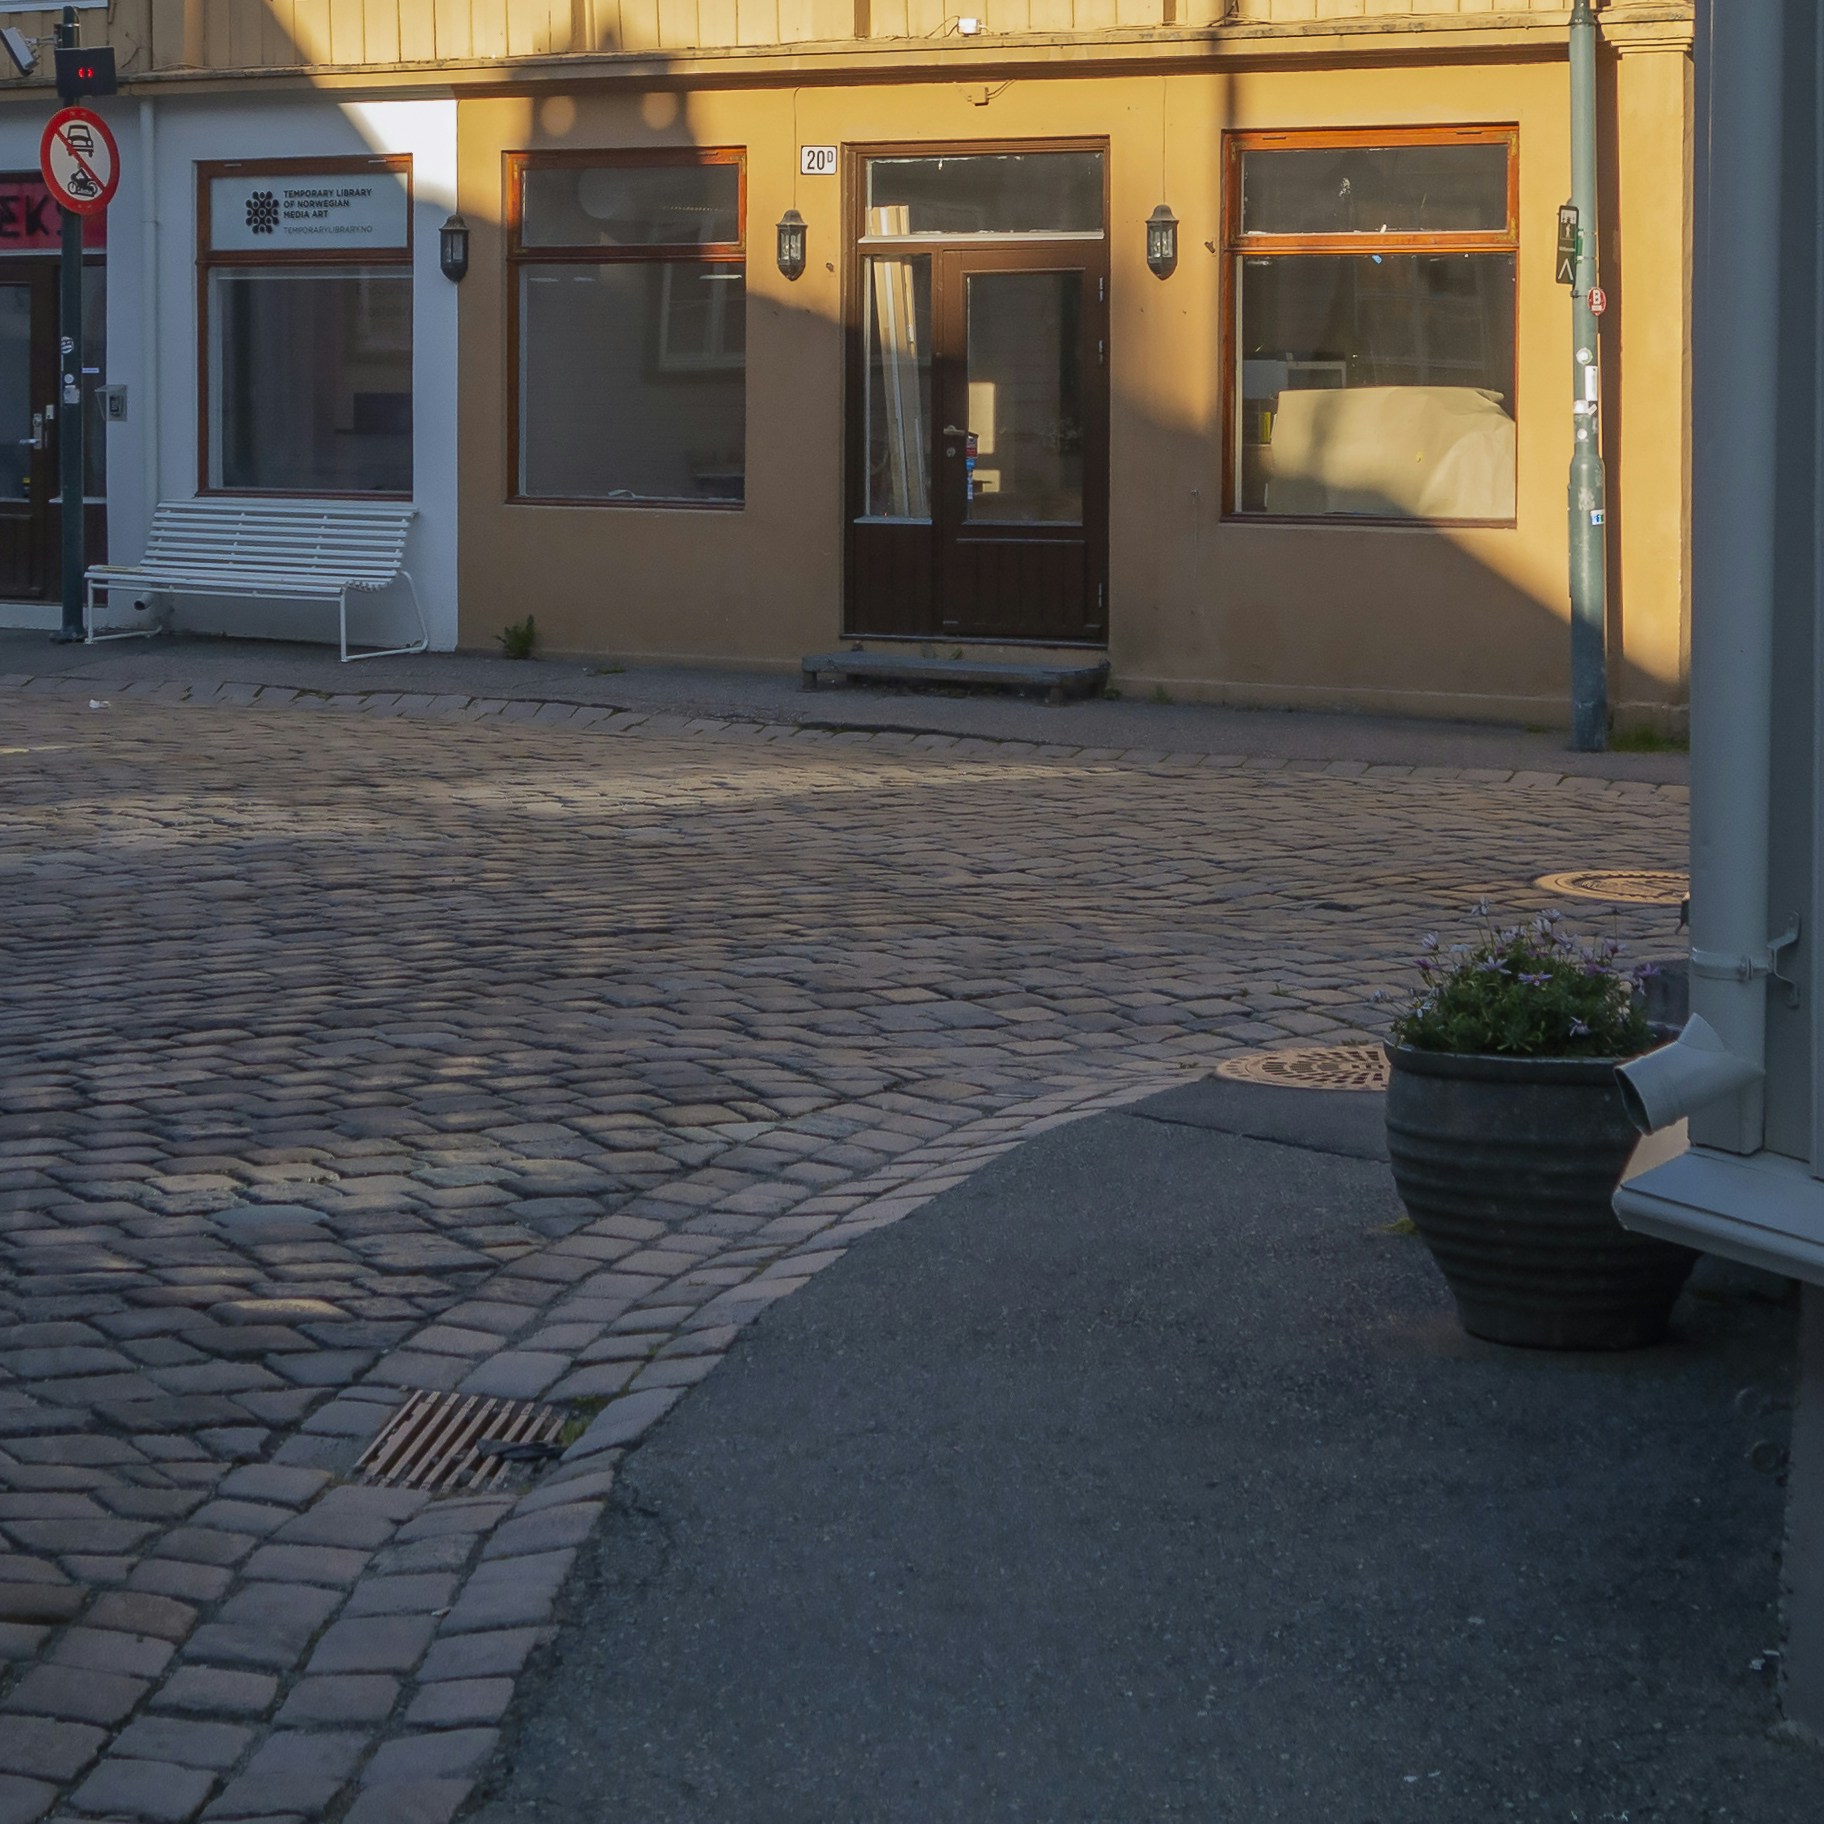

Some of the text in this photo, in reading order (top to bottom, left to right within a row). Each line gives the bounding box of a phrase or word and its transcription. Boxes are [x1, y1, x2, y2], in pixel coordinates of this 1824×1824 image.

[283, 188, 373, 198] TEMPORARY LIBRARY
[283, 199, 350, 208] OF NORWEGIAN
[283, 209, 329, 219] MEDIA ART
